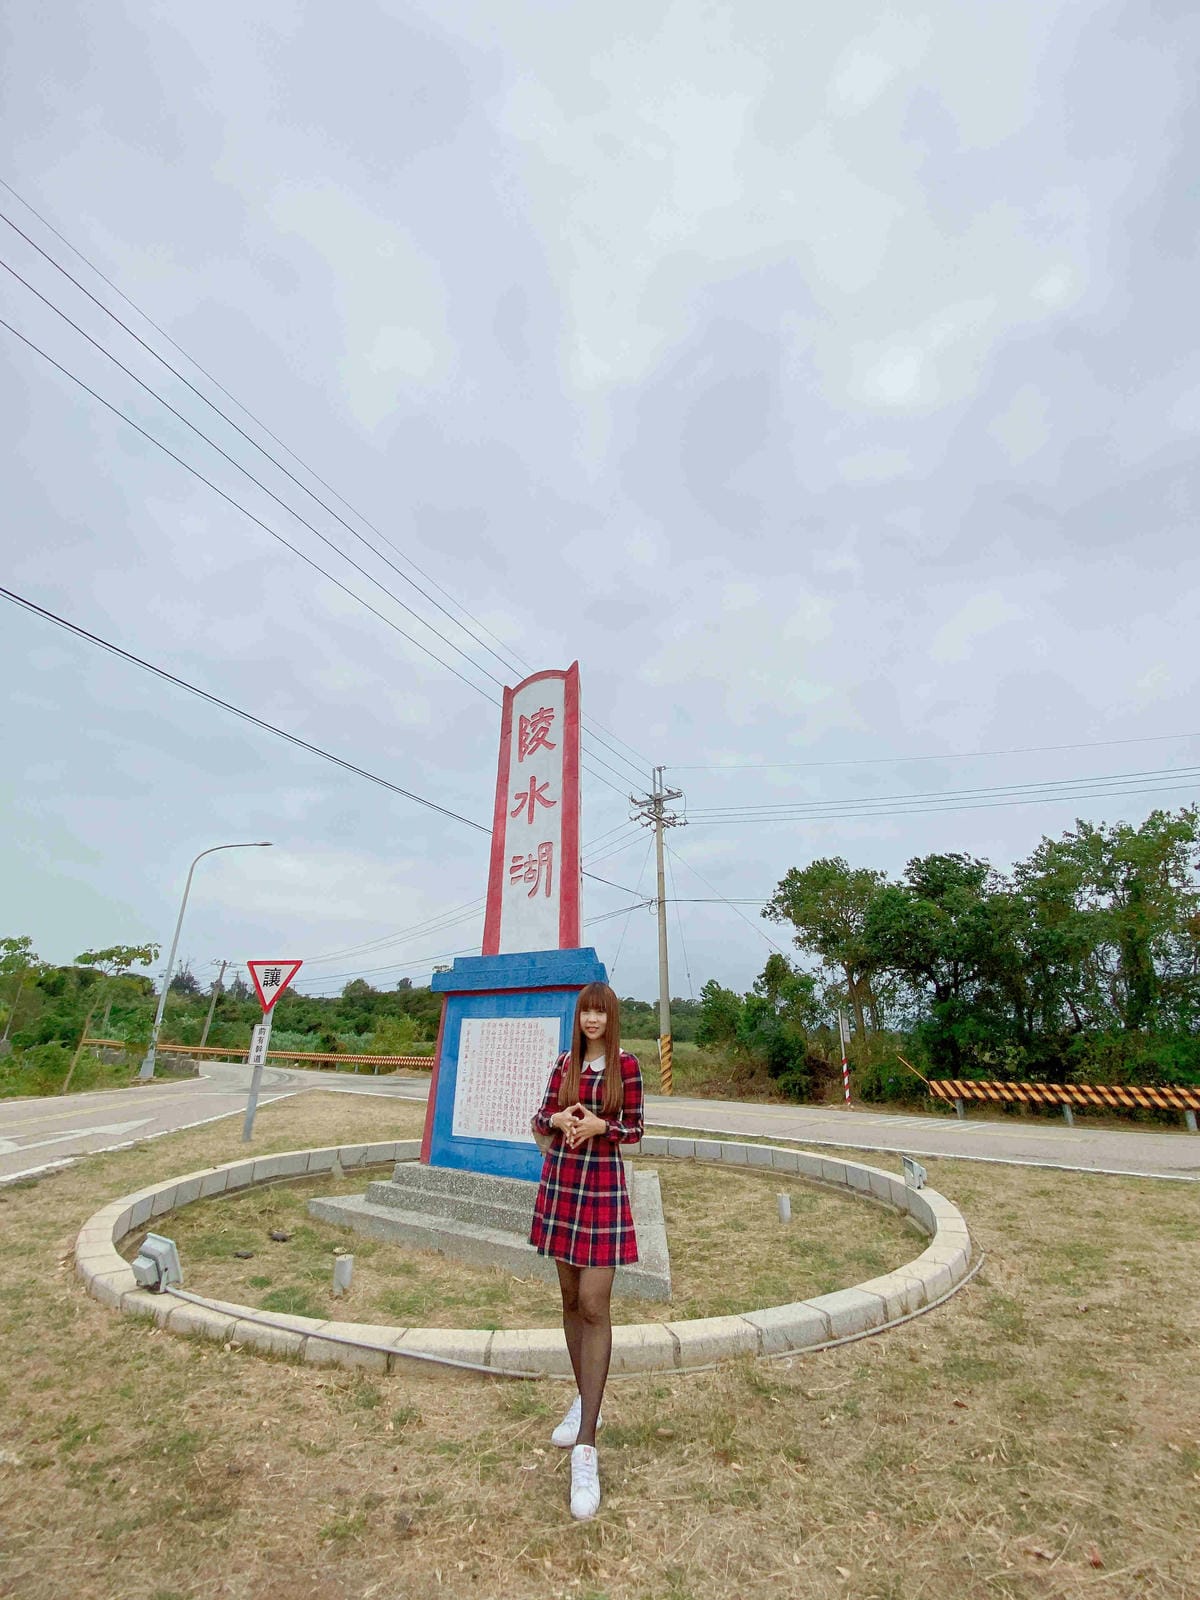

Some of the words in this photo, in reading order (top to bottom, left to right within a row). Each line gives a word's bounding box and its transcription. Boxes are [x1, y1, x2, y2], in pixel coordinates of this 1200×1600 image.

[509, 707, 557, 898] 陵水湖
[263, 968, 281, 987] 讓
[254, 1027, 266, 1063] 前有幹道
